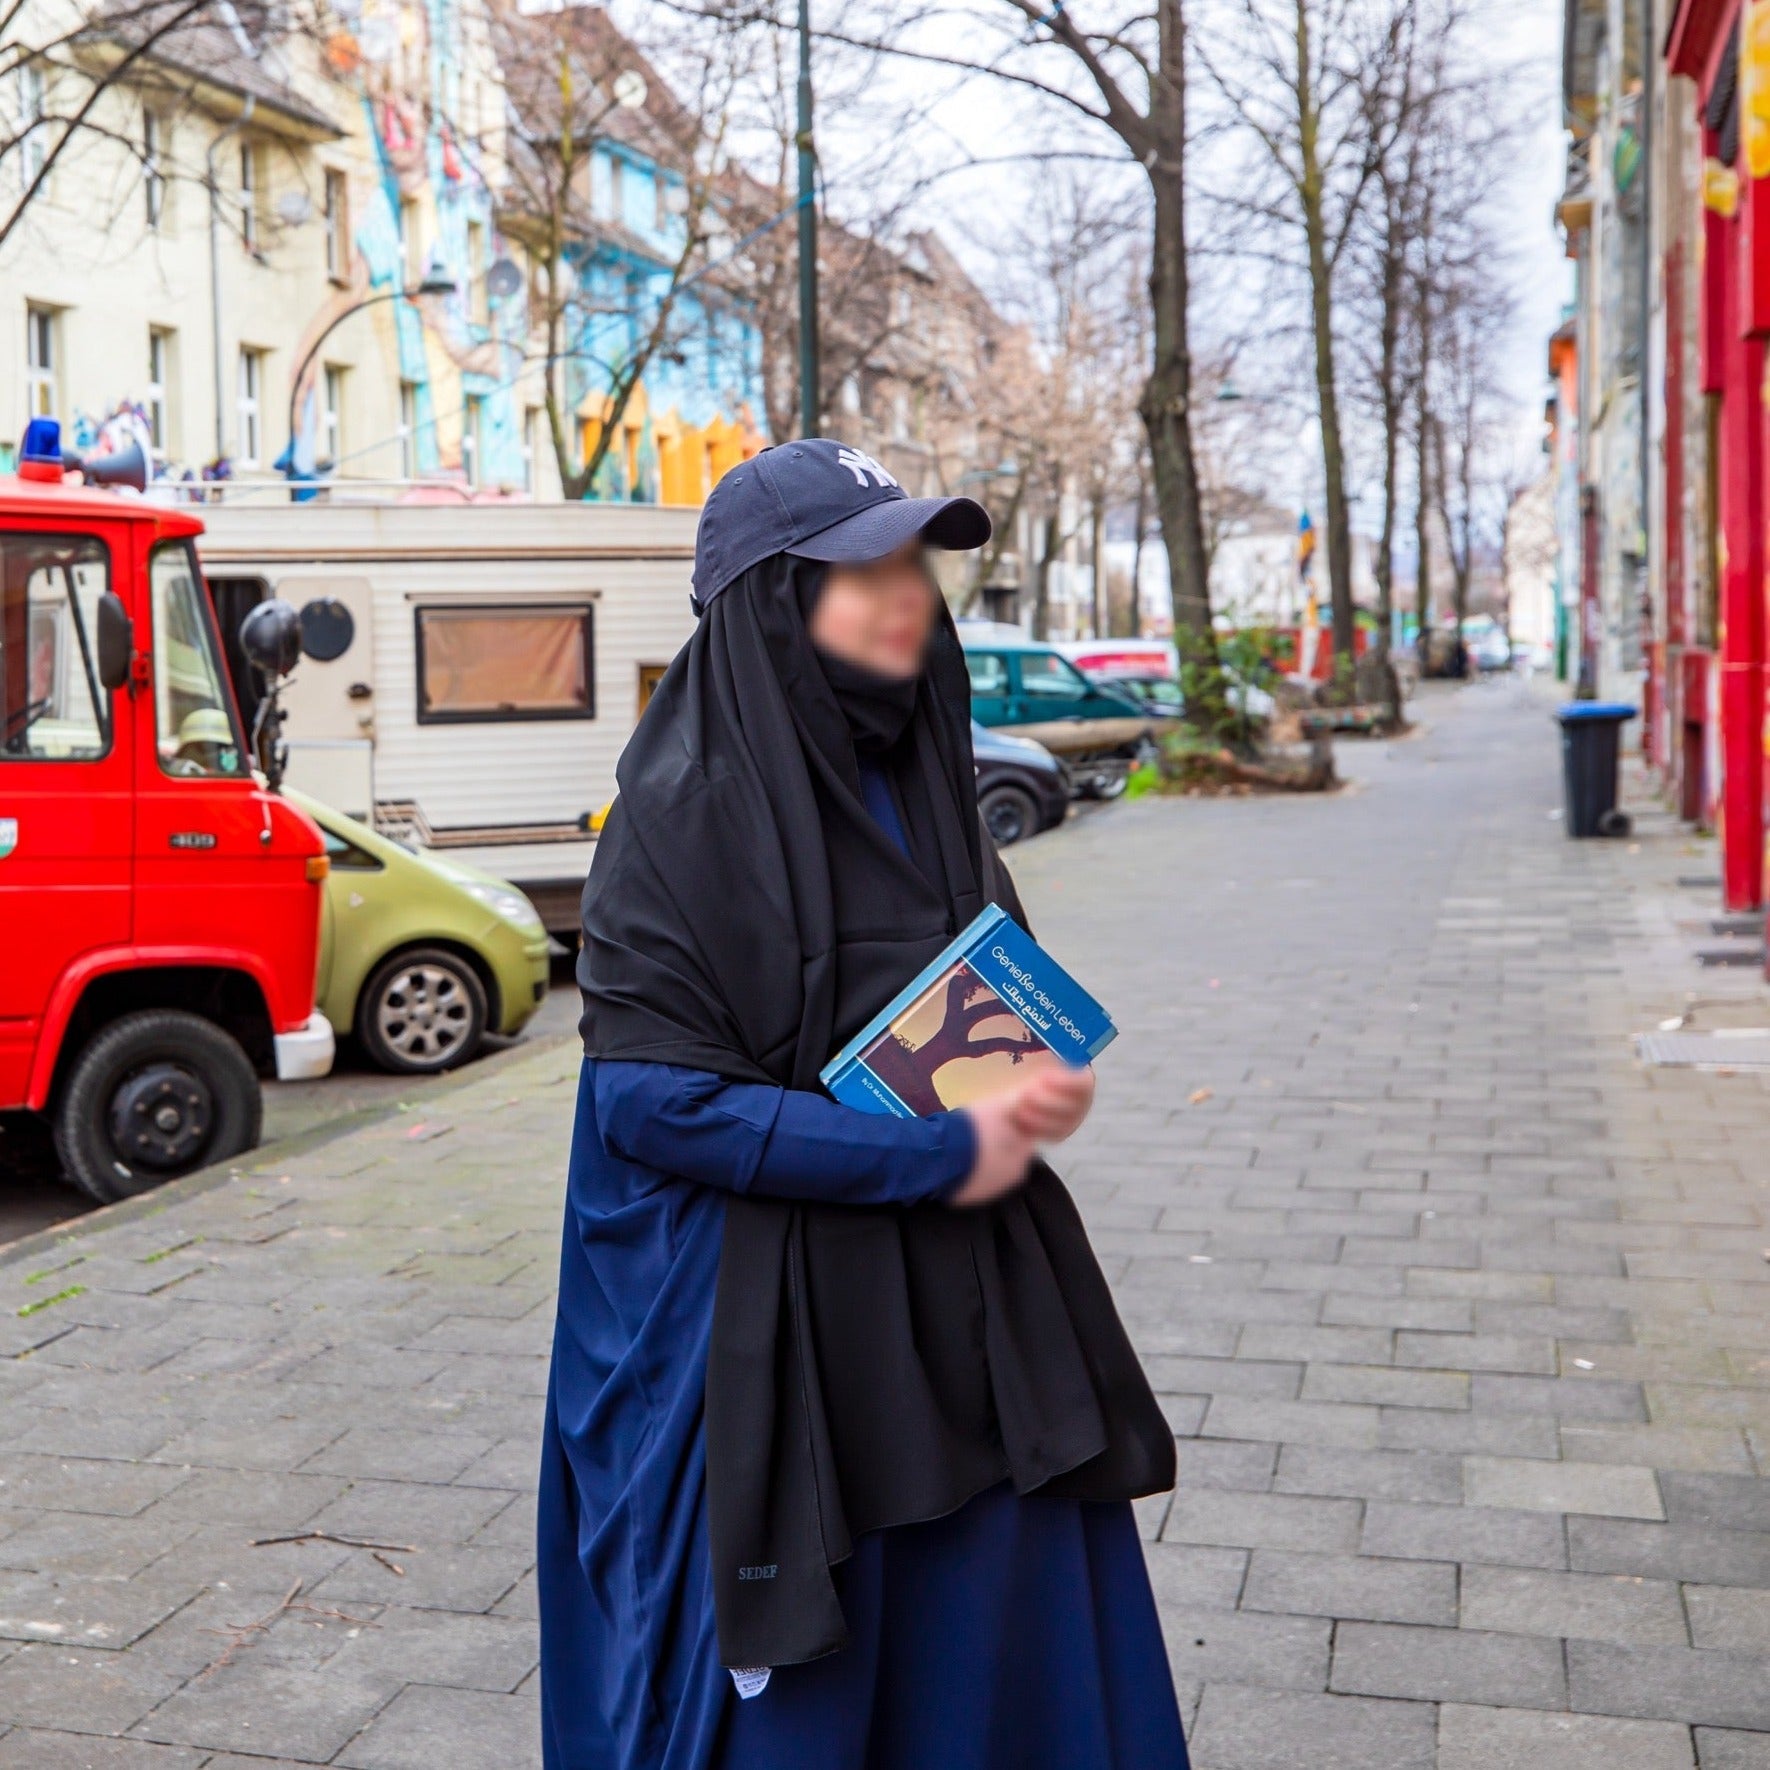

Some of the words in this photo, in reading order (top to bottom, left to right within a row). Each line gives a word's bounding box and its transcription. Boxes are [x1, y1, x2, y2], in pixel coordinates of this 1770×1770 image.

[992, 946, 1035, 992] Genieße
[1033, 990, 1056, 1014] dein
[1053, 1008, 1086, 1045] Leben
[1002, 982, 1026, 1009] بحياتك
[1021, 1005, 1052, 1031] استمتع
[738, 1564, 777, 1580] SEDEF
